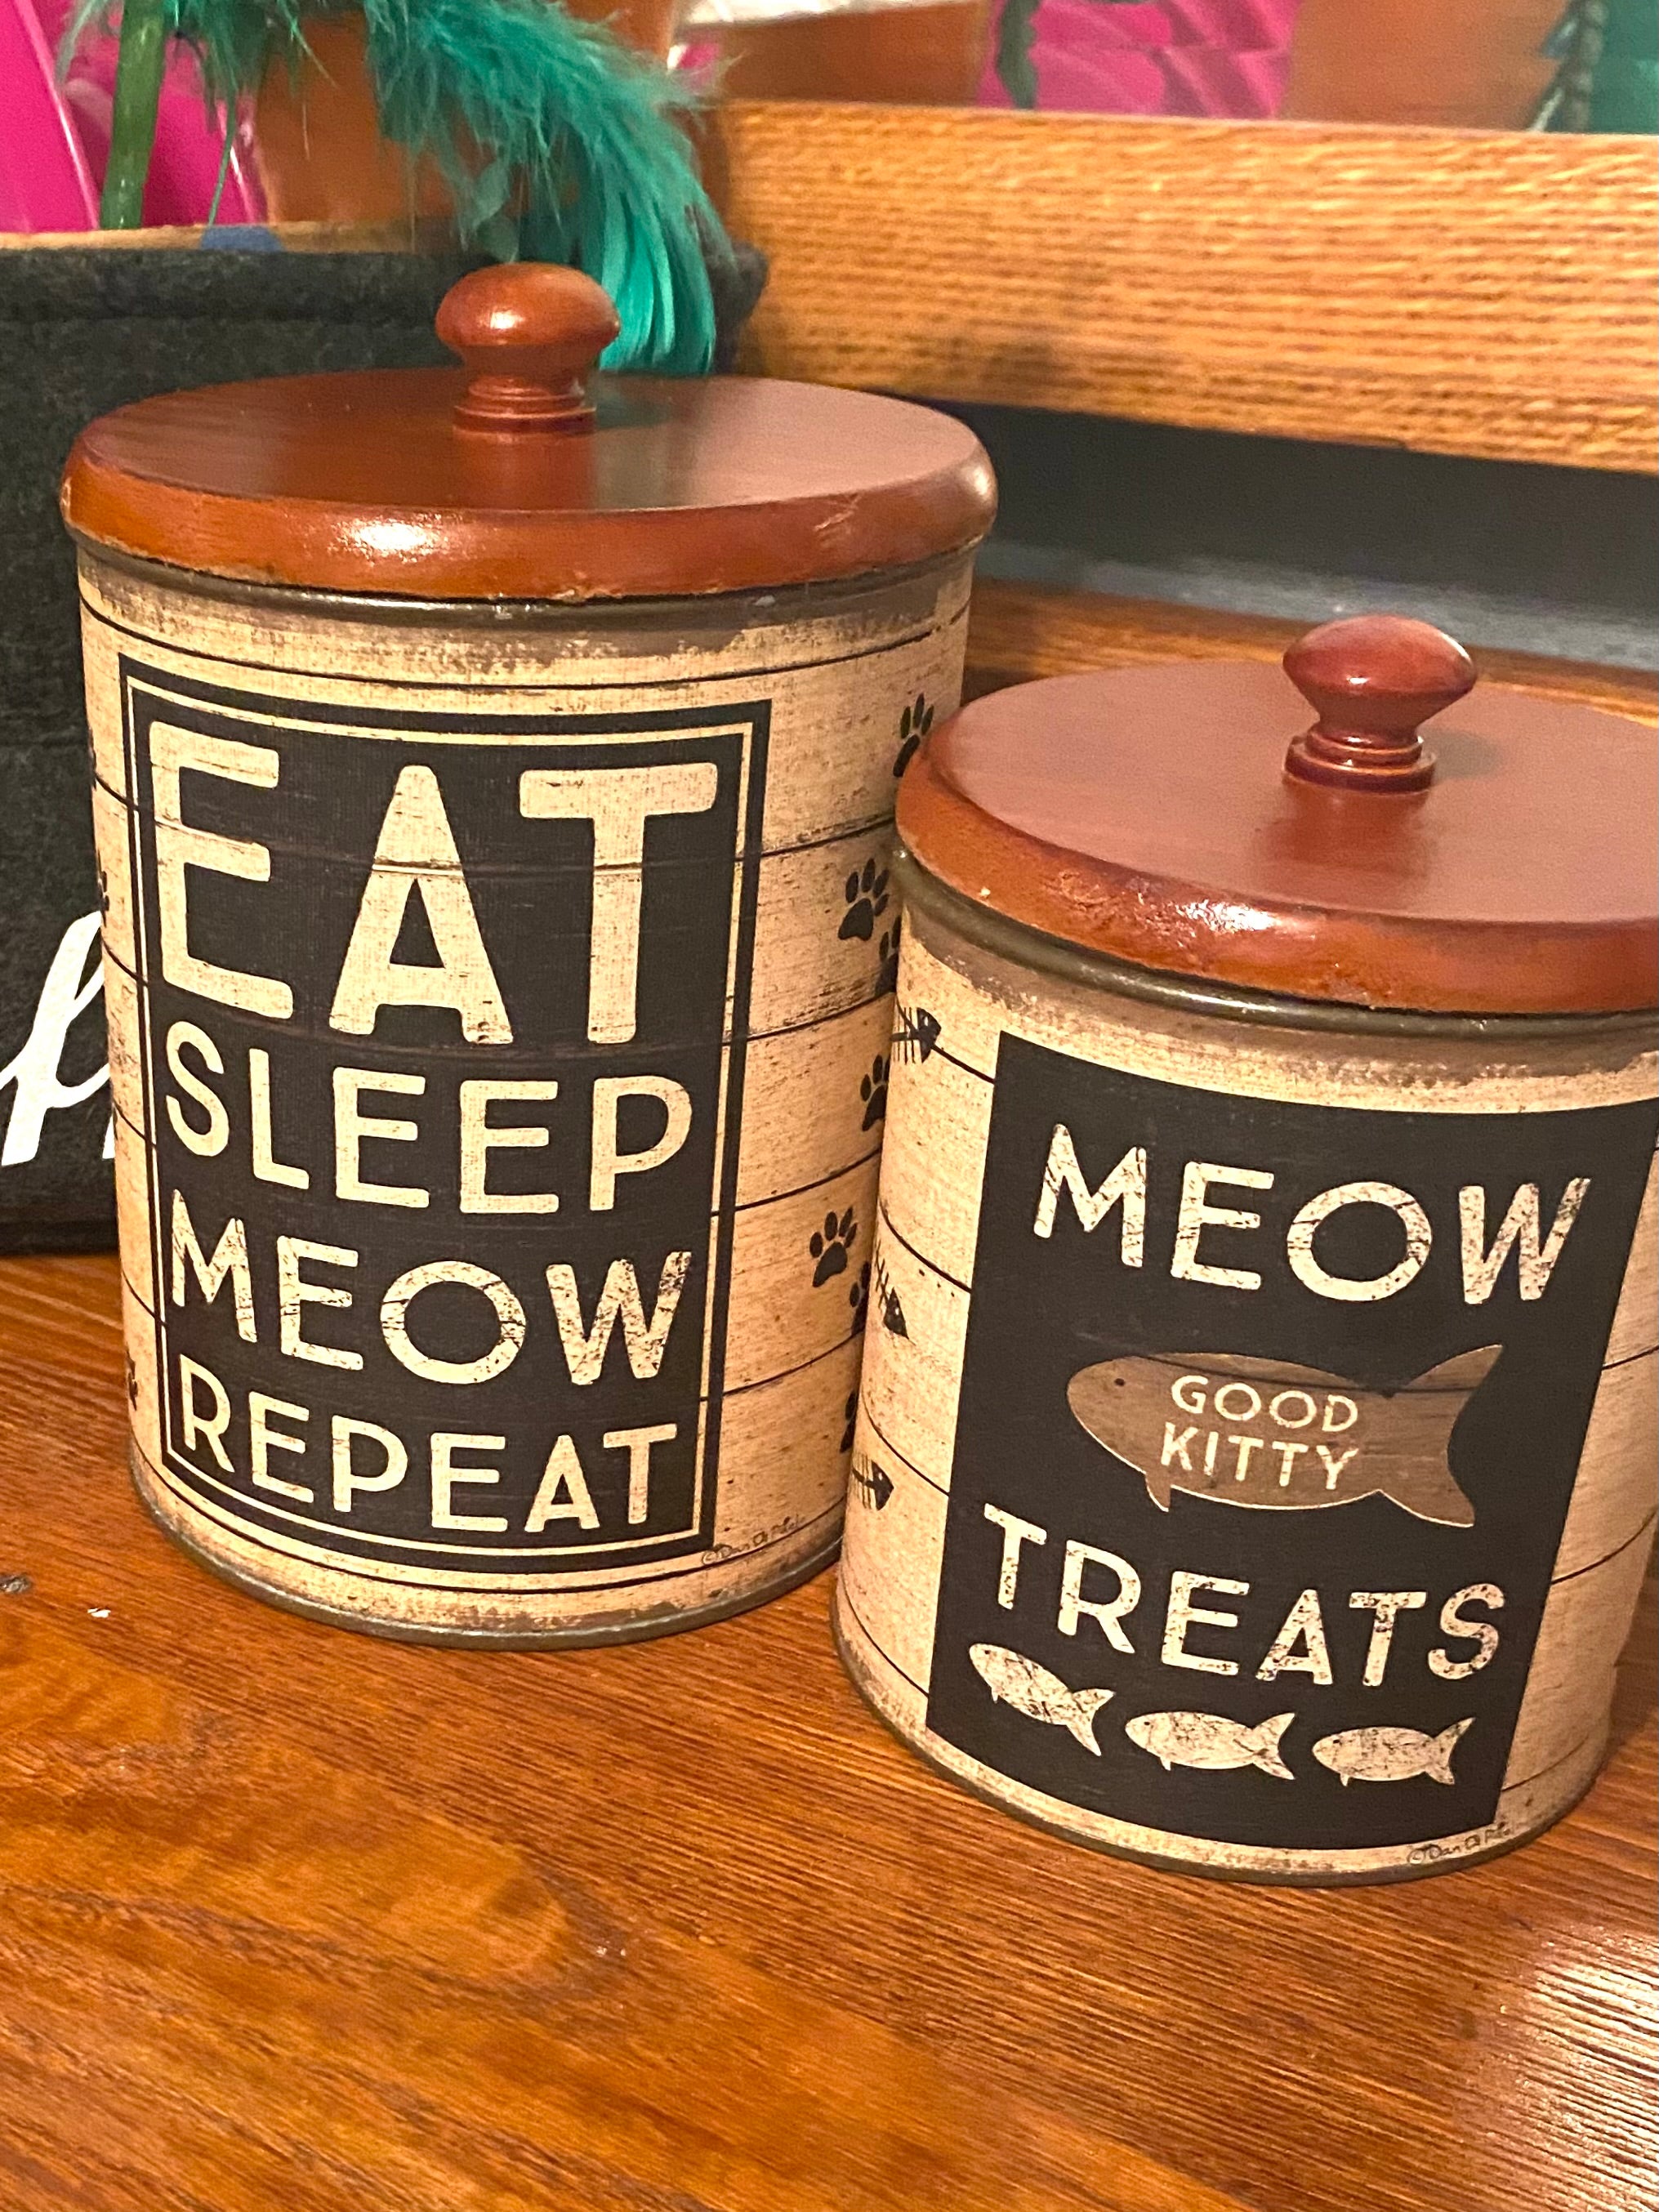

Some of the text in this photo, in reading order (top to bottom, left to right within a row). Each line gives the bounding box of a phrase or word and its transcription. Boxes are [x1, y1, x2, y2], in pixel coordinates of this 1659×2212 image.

[149, 721, 717, 1043] EAT
[167, 1023, 692, 1213] SLEEP
[172, 1193, 691, 1385] MEOW
[1034, 1125, 1590, 1302] MEOW
[180, 1356, 677, 1533] REPEAT
[1161, 1422, 1359, 1489] KITTY
[1171, 1376, 1358, 1431] GOOD
[985, 1505, 1505, 1685] TREATS
